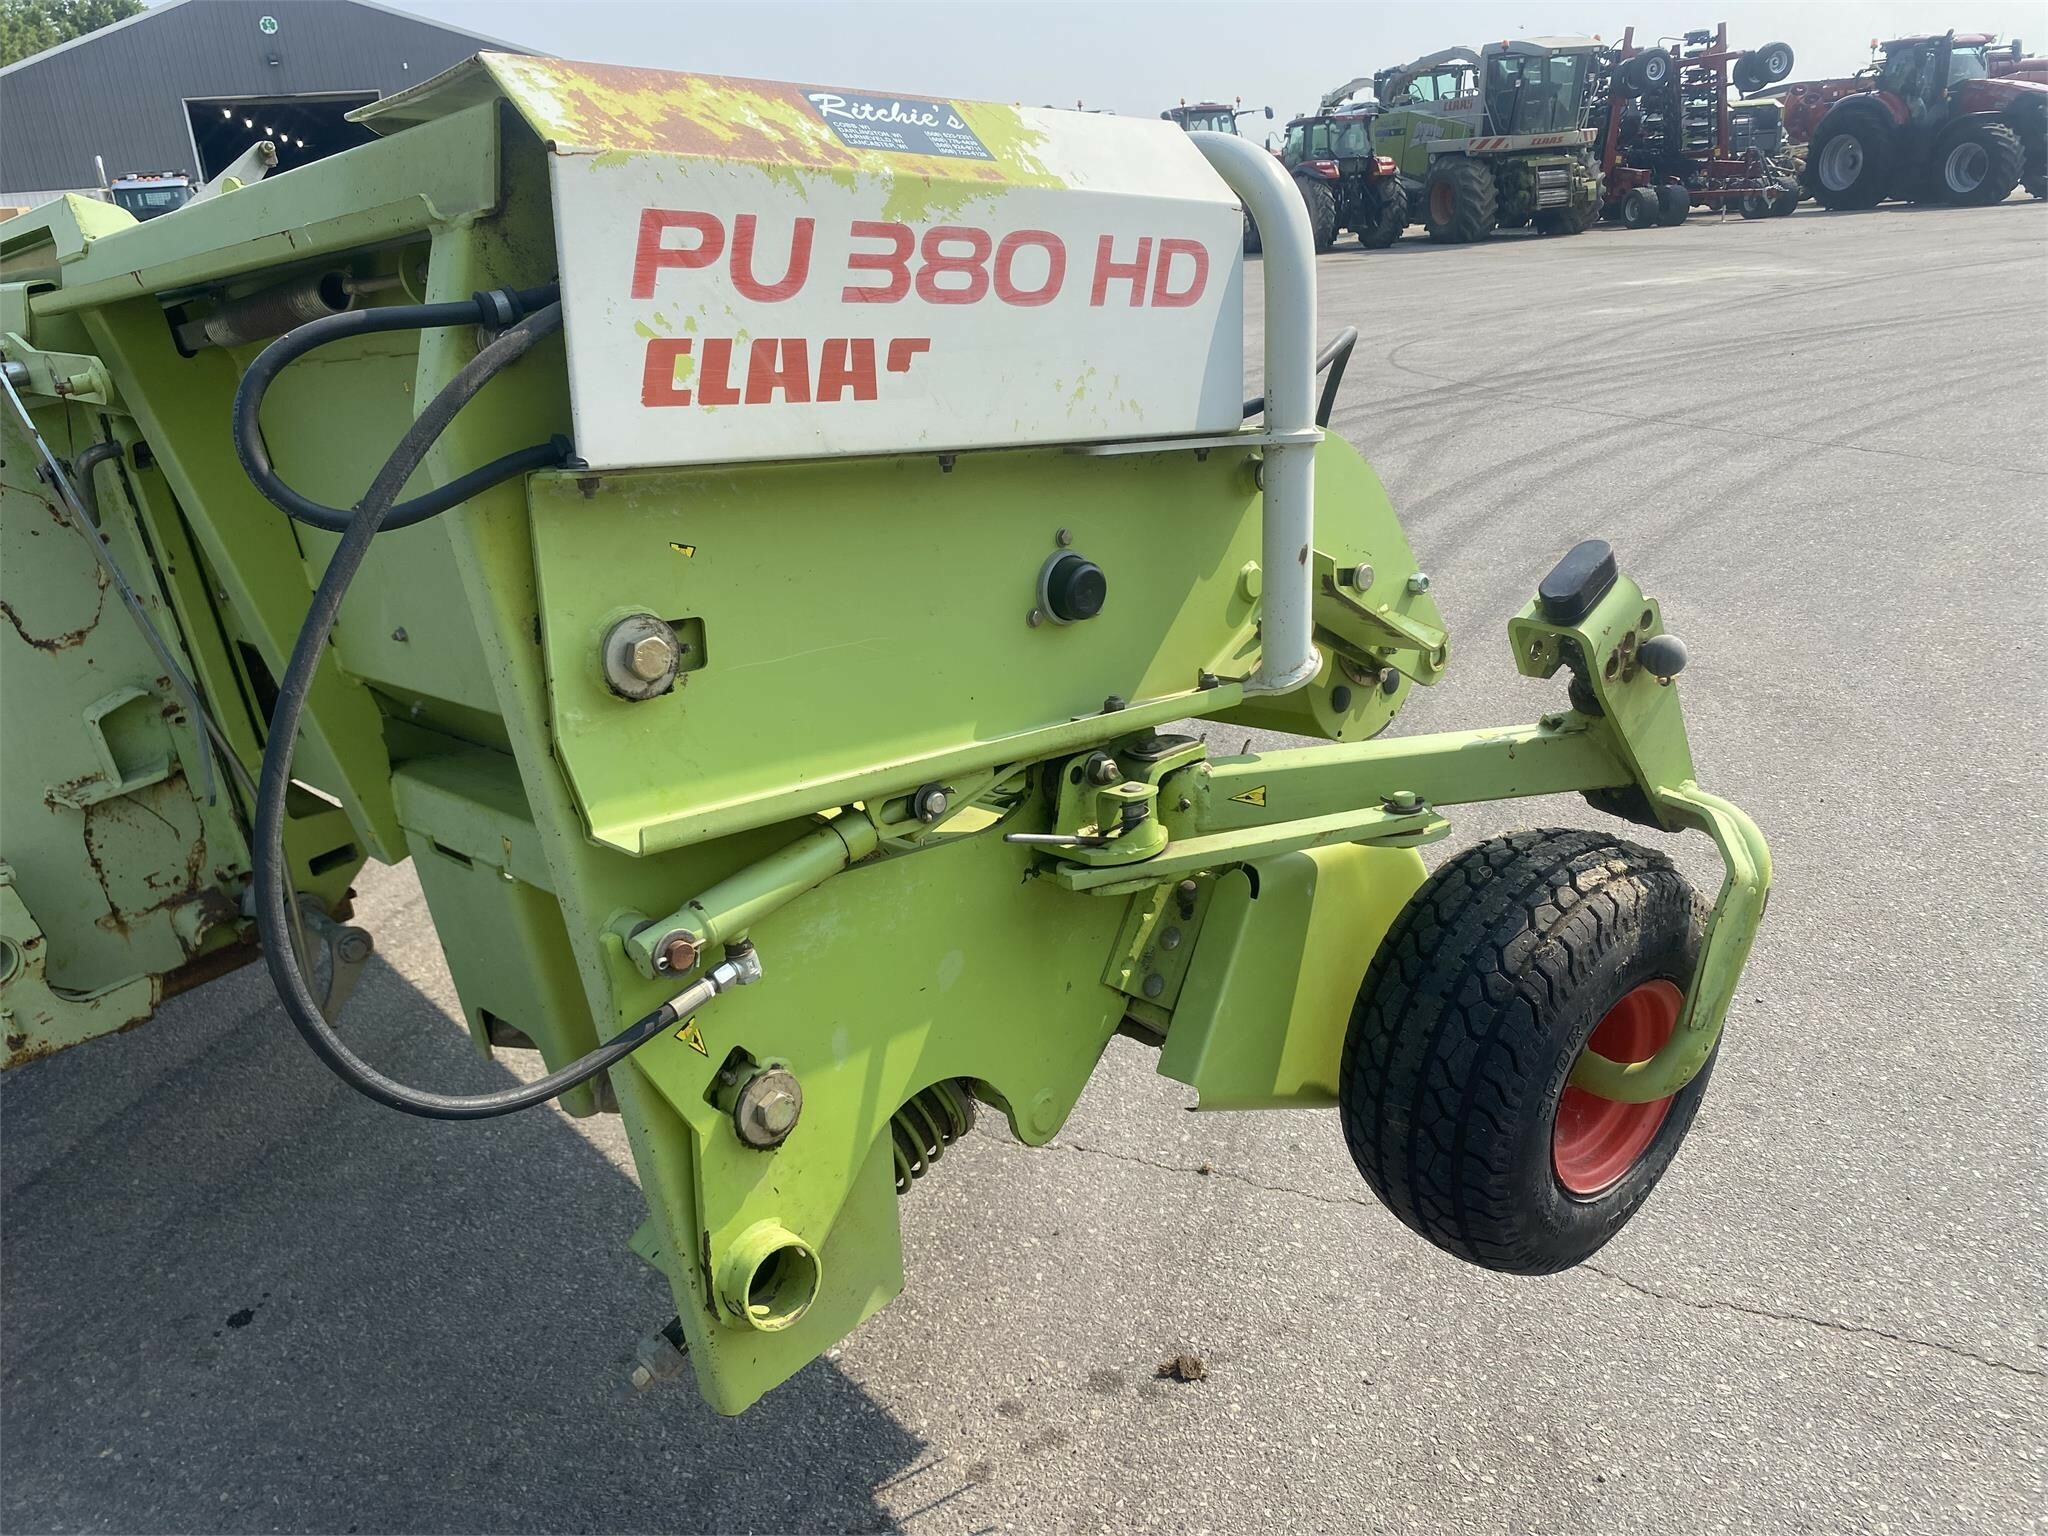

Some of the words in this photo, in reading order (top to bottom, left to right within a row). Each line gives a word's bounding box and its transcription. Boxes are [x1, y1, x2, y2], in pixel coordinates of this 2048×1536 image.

[808, 93, 965, 130] Ritchie's
[1443, 100, 1473, 112] CLAAS
[1530, 136, 1564, 146] CLAAS
[631, 208, 815, 303] PU
[841, 220, 1067, 306] 380
[1089, 234, 1211, 308] HD
